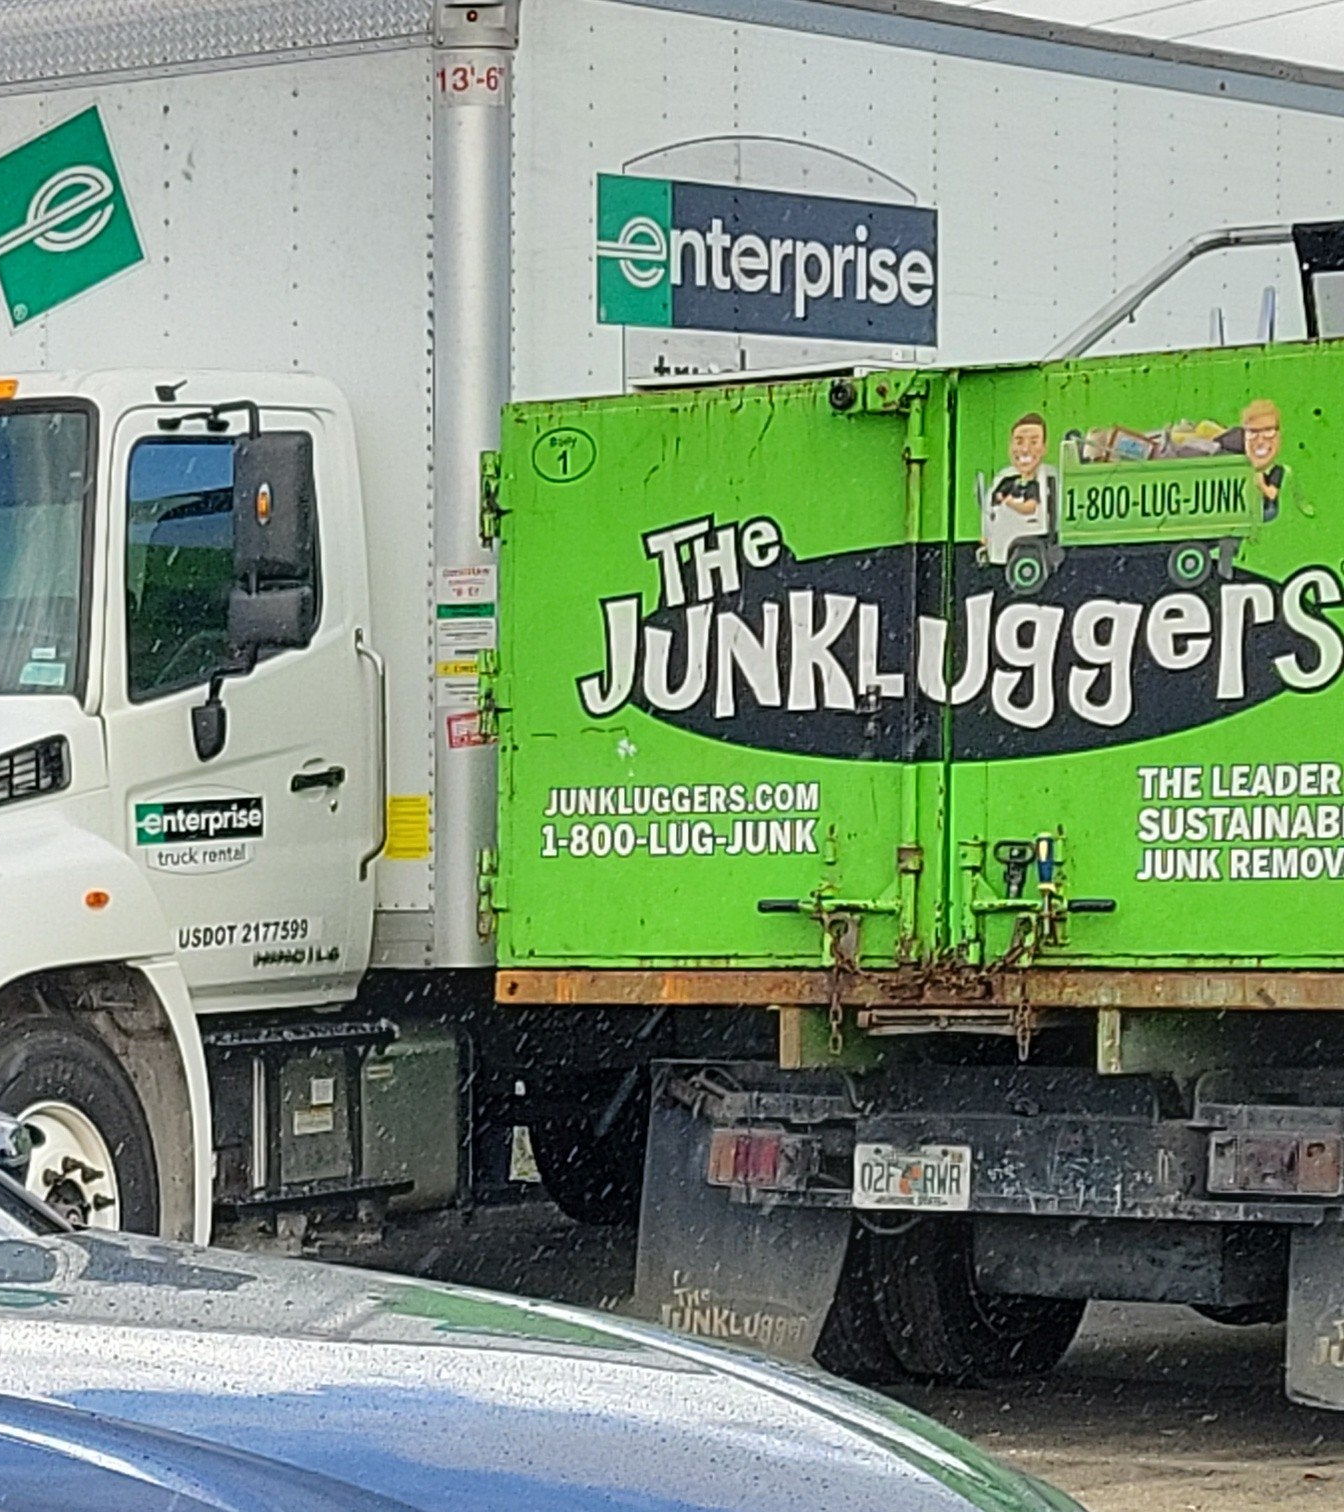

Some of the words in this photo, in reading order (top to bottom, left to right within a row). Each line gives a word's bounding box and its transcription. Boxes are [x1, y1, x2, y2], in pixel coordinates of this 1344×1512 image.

[597, 216, 935, 319] enterprise
[557, 450, 567, 475] 1
[1065, 477, 1248, 522] 1-800-LUG-JUNK
[1138, 766, 1203, 799] THE
[1212, 763, 1342, 797] LEADER
[543, 782, 820, 817] JUNKLUGGERS.COM
[137, 803, 262, 836] enterprise
[1138, 804, 1344, 842] SUSTAINAB
[158, 848, 199, 867] truck
[202, 844, 247, 864] rental
[540, 819, 818, 857] 1-800-LUG-JUNK
[1137, 848, 1222, 881] JUNK
[1230, 848, 1344, 880] REMOV
[179, 924, 238, 949] USDOT
[241, 918, 309, 944] 2177599
